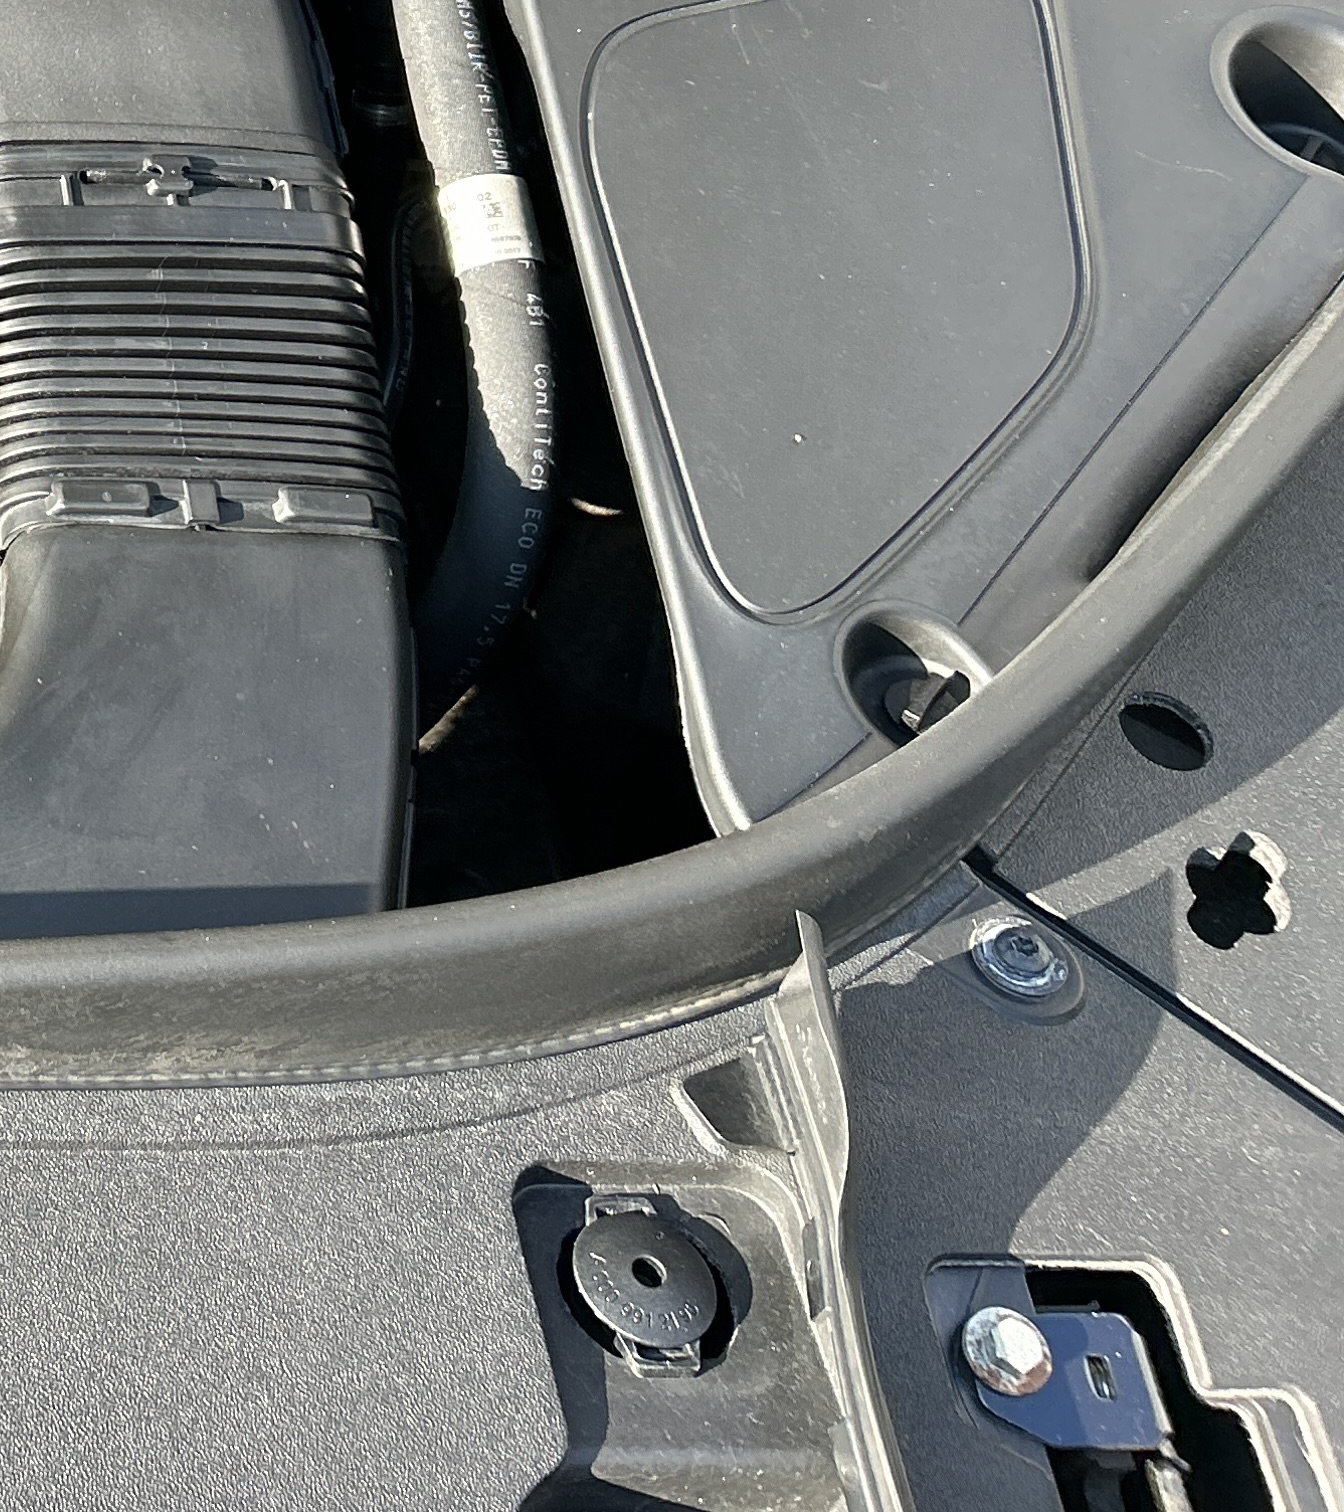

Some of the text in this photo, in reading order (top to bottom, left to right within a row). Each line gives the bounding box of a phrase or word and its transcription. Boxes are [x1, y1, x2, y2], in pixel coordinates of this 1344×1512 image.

[528, 362, 552, 492] ContiTech
[518, 507, 543, 550] ECO
[503, 561, 528, 589] DN
